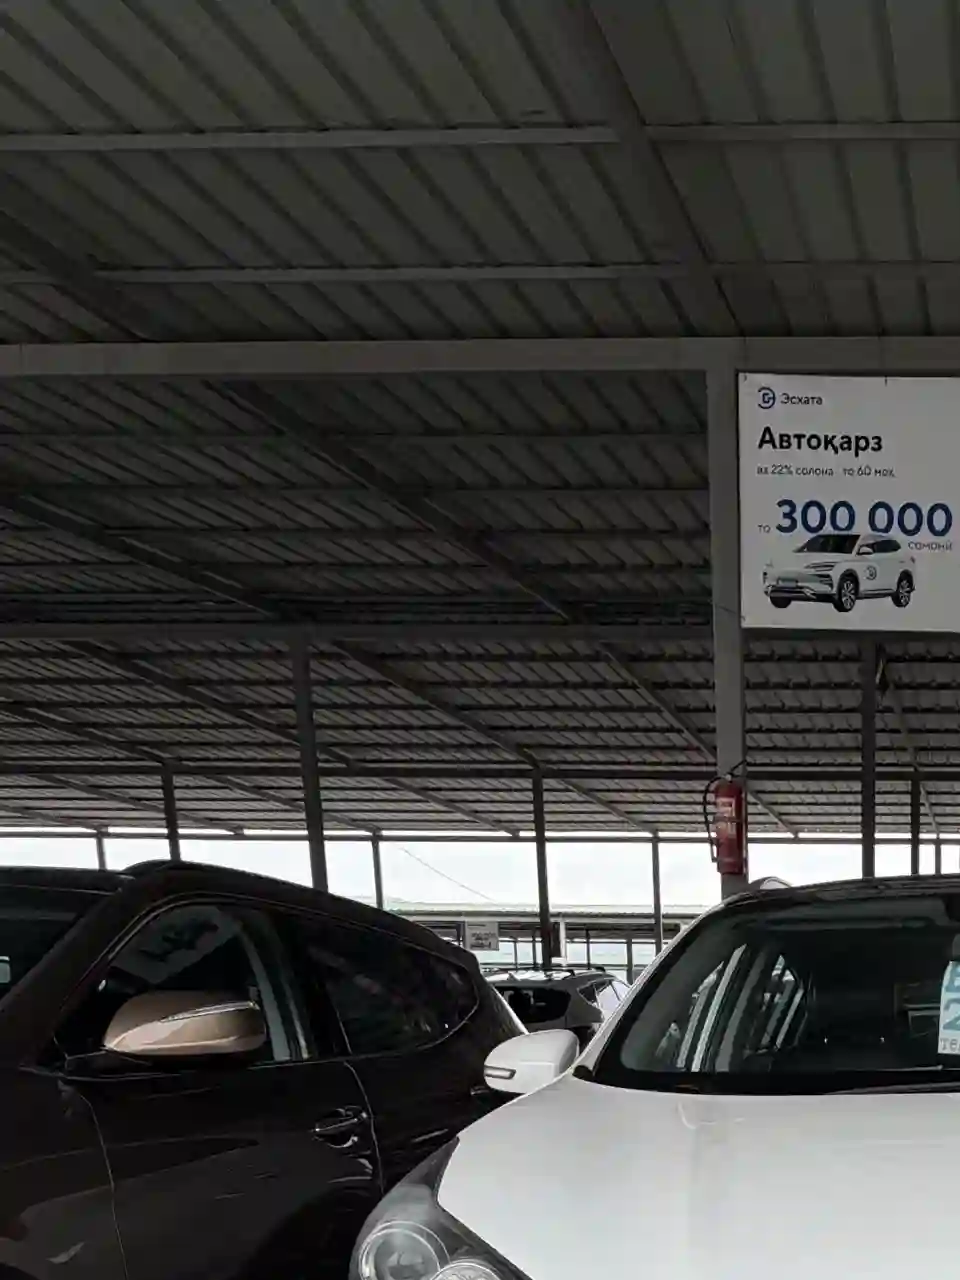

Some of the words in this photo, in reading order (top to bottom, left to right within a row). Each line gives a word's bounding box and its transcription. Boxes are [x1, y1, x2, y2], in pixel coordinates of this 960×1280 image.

[780, 392, 823, 406] Эсхата
[757, 425, 883, 457] Автоқарз
[771, 464, 793, 476] 22%
[857, 465, 872, 476] 60
[757, 523, 771, 534] то
[775, 498, 856, 534] 300
[868, 500, 953, 537] 000
